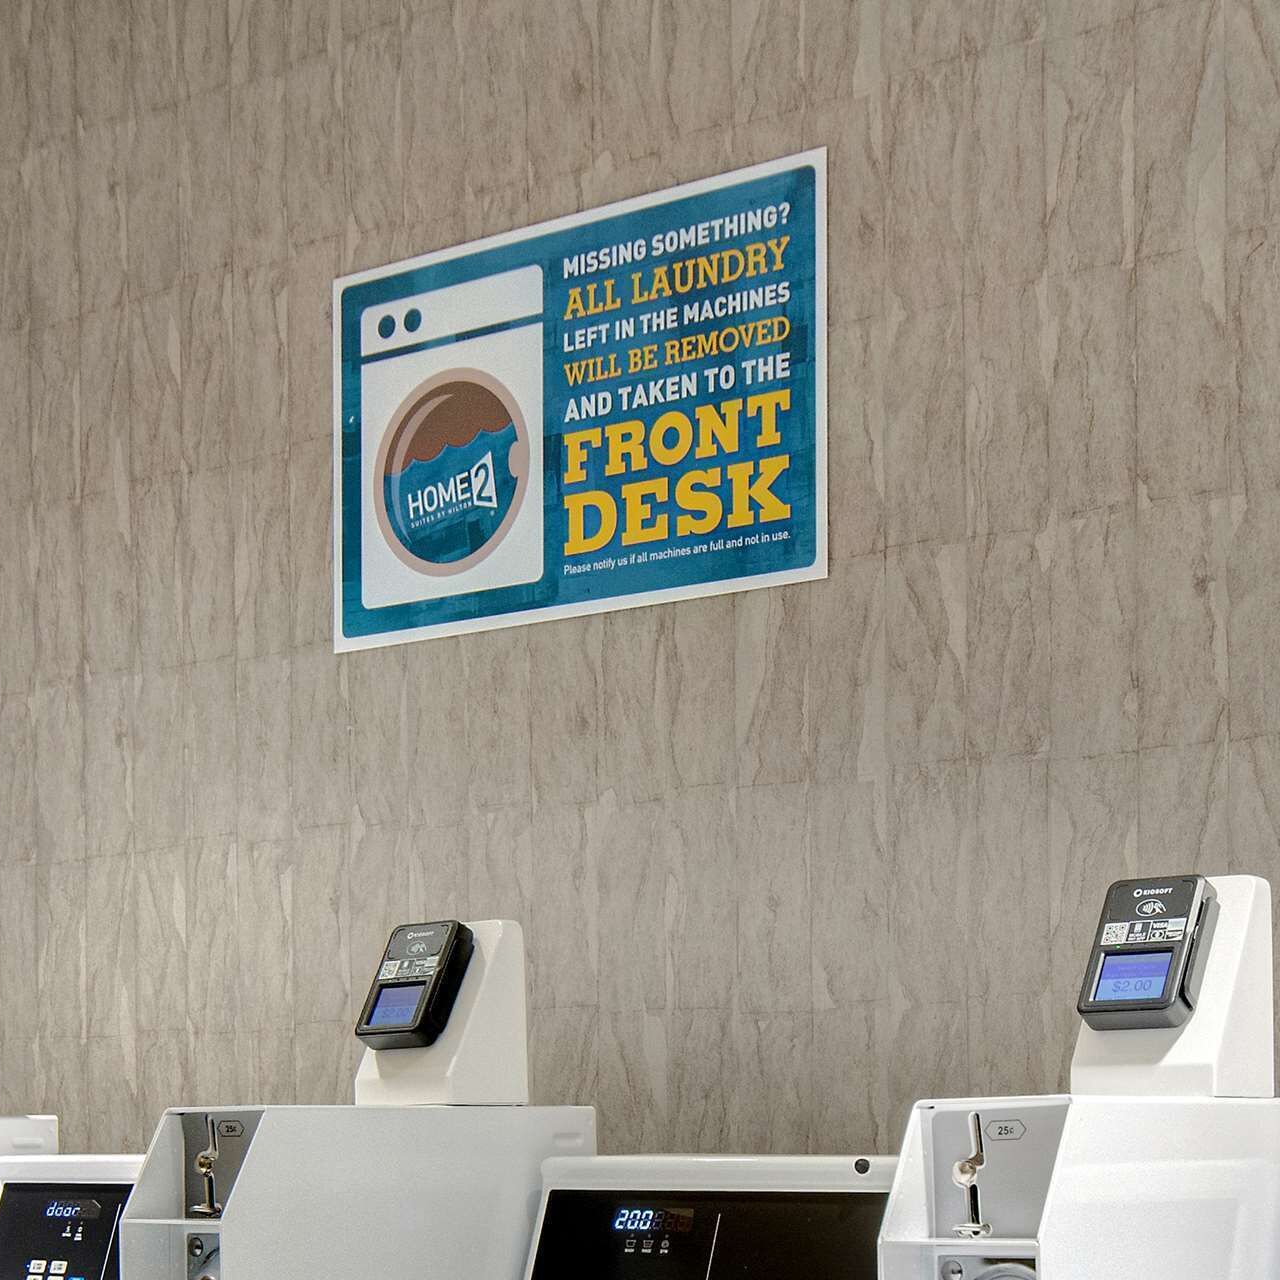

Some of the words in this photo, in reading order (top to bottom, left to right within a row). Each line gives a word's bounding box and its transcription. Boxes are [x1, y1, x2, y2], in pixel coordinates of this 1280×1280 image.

[563, 238, 647, 279] MISSING
[651, 201, 791, 256] SOMETHING?
[563, 278, 622, 321] ALL
[631, 235, 791, 304] LAUNDRY
[563, 323, 610, 352] LEFT
[615, 317, 635, 341] IN
[639, 306, 679, 334] THE
[683, 281, 791, 325] MACHINES
[563, 353, 622, 387] WILL
[628, 344, 659, 374] BE
[664, 316, 791, 365] REMOVED
[564, 391, 612, 423] AND
[618, 372, 697, 411] TAKEN
[703, 364, 736, 393] TO
[741, 352, 791, 385] THE
[563, 388, 792, 485] FRONT
[410, 514, 435, 529] SUITES
[448, 500, 472, 514] HILTON
[563, 454, 792, 556] DESK
[563, 563, 592, 575] Please
[592, 556, 616, 571] notify
[617, 557, 629, 567] us
[629, 553, 636, 565] if
[636, 551, 648, 563] all
[649, 546, 692, 562] machines
[692, 543, 708, 555] are
[709, 538, 724, 552] full
[725, 536, 743, 550] and
[744, 533, 760, 546] not
[761, 532, 770, 543] in
[771, 530, 791, 542] use.
[1112, 980, 1153, 993] $2.00
[614, 1209, 654, 1230] 200
